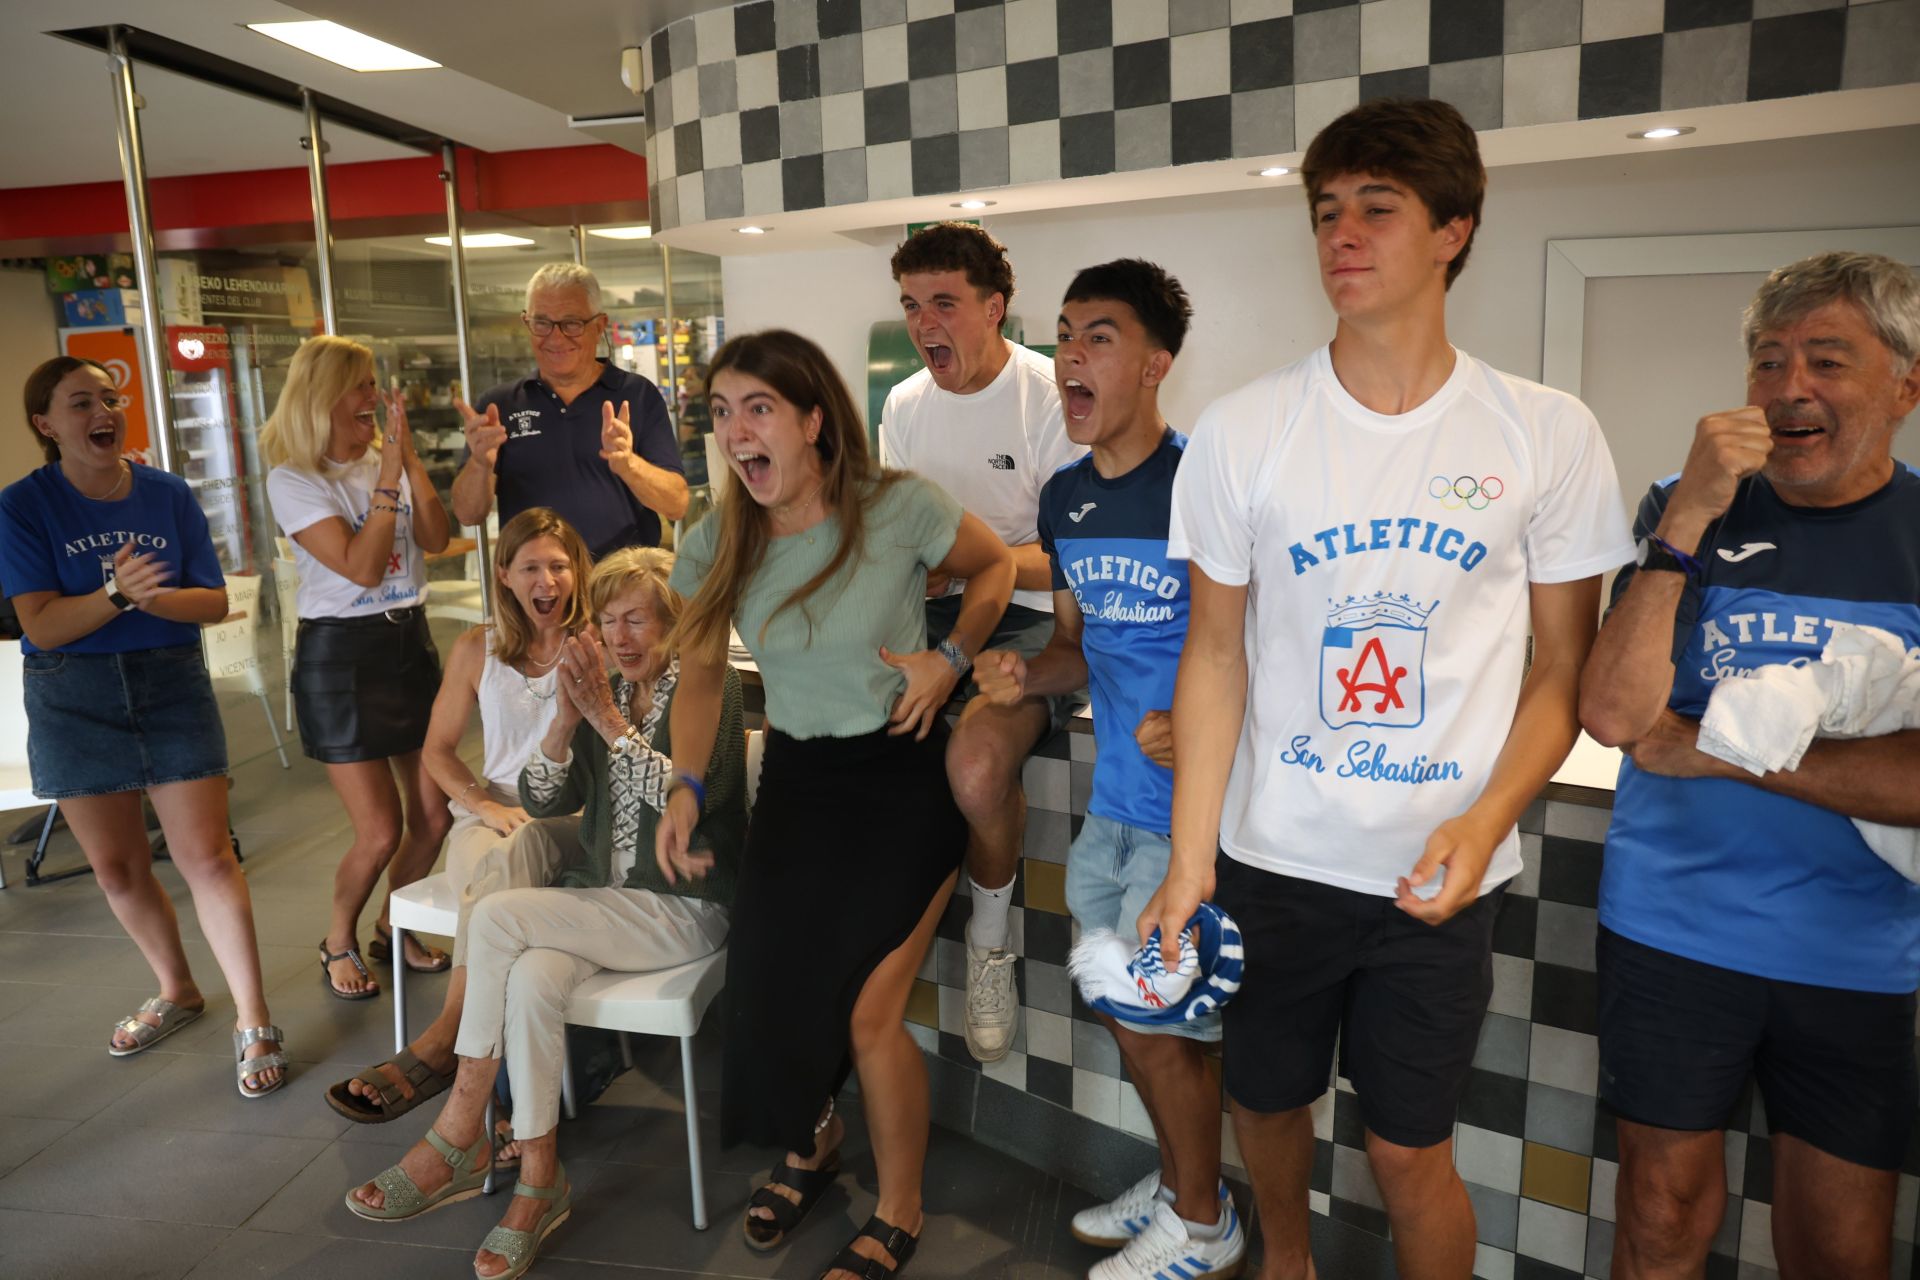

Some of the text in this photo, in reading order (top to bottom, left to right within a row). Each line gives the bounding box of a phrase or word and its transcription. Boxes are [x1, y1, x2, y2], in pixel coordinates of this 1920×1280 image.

[224, 278, 298, 295] LEHENDAKAR
[64, 530, 168, 557] ATLETICO
[1288, 517, 1488, 576] ATLETICO
[379, 584, 419, 602] Sebasti
[1064, 555, 1180, 600] ATLETICO
[1074, 589, 1175, 623] San Sebastian
[1280, 735, 1463, 784] San Sebastian
